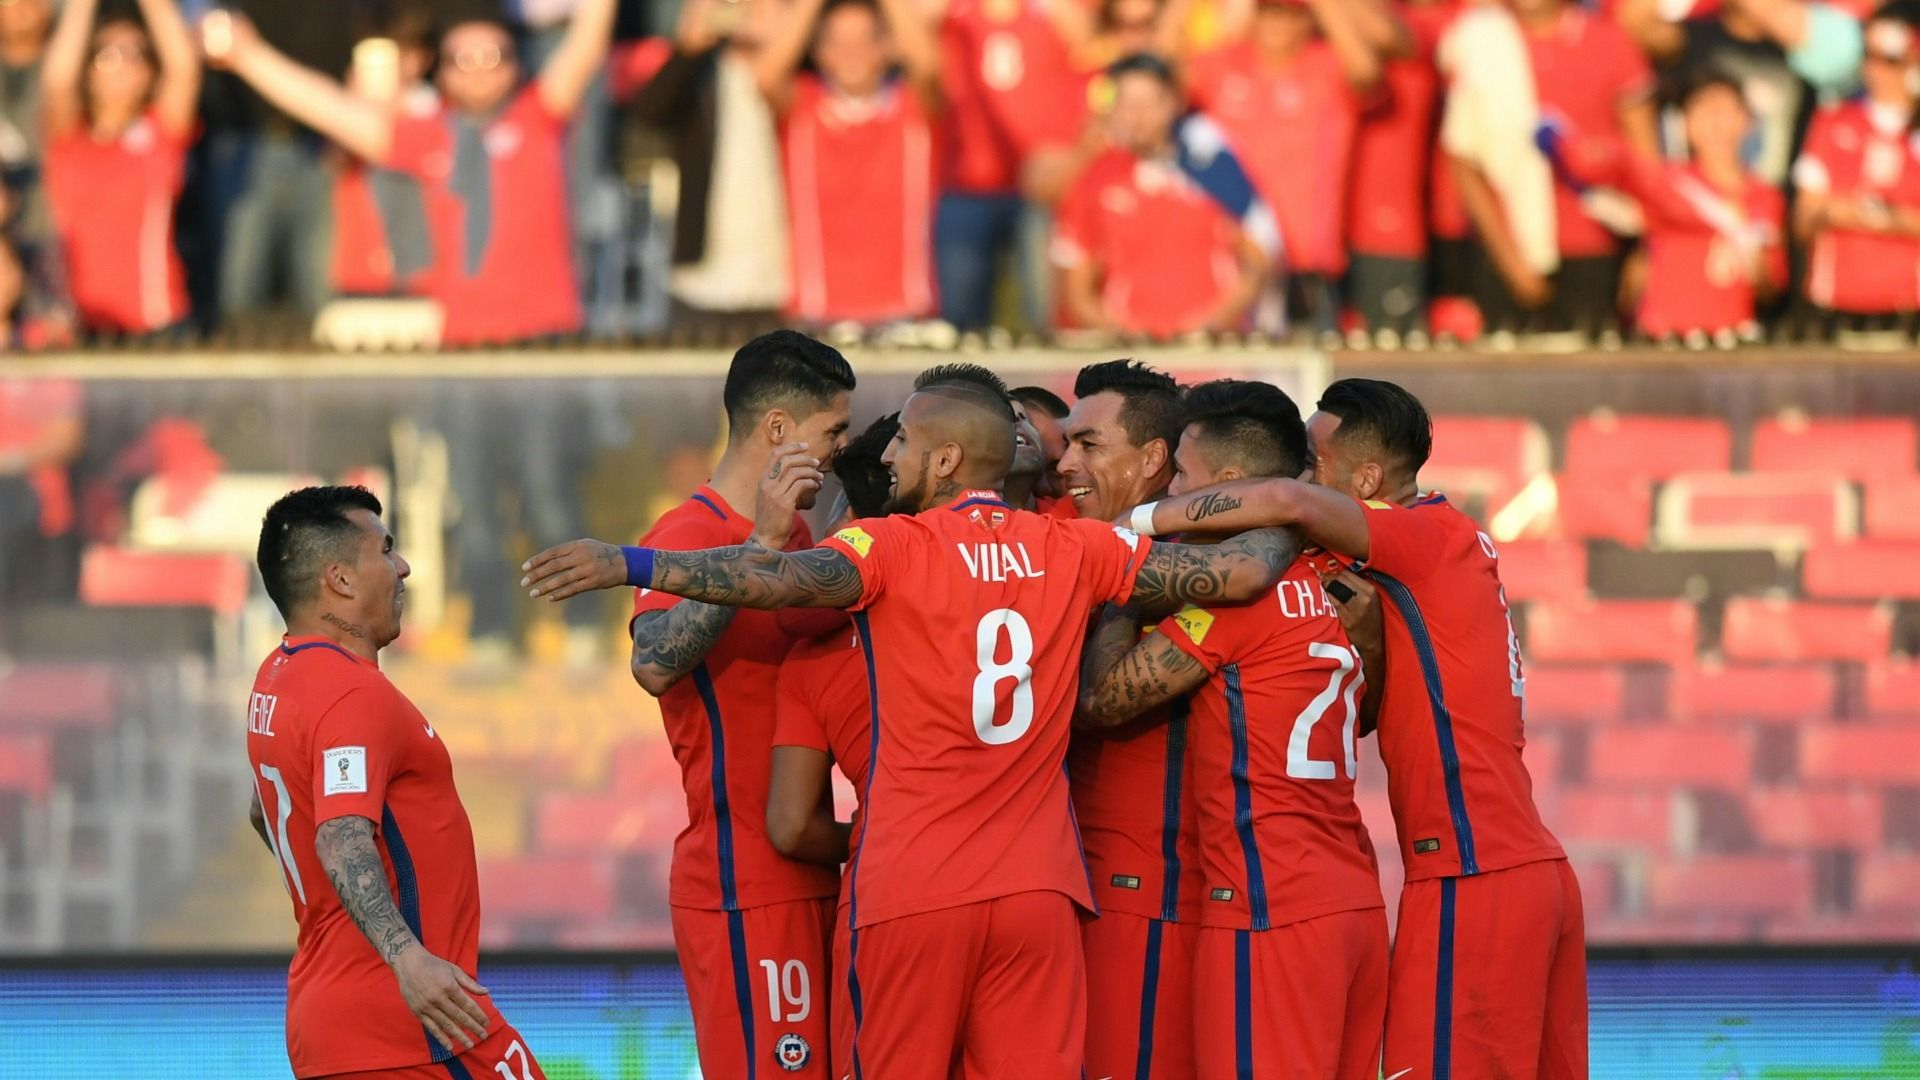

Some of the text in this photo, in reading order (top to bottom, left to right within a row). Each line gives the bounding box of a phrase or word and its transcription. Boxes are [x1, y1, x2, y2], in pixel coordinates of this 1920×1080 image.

[1277, 579, 1338, 618] CH.A
[972, 608, 1034, 745] 8
[760, 959, 811, 1022] 19
